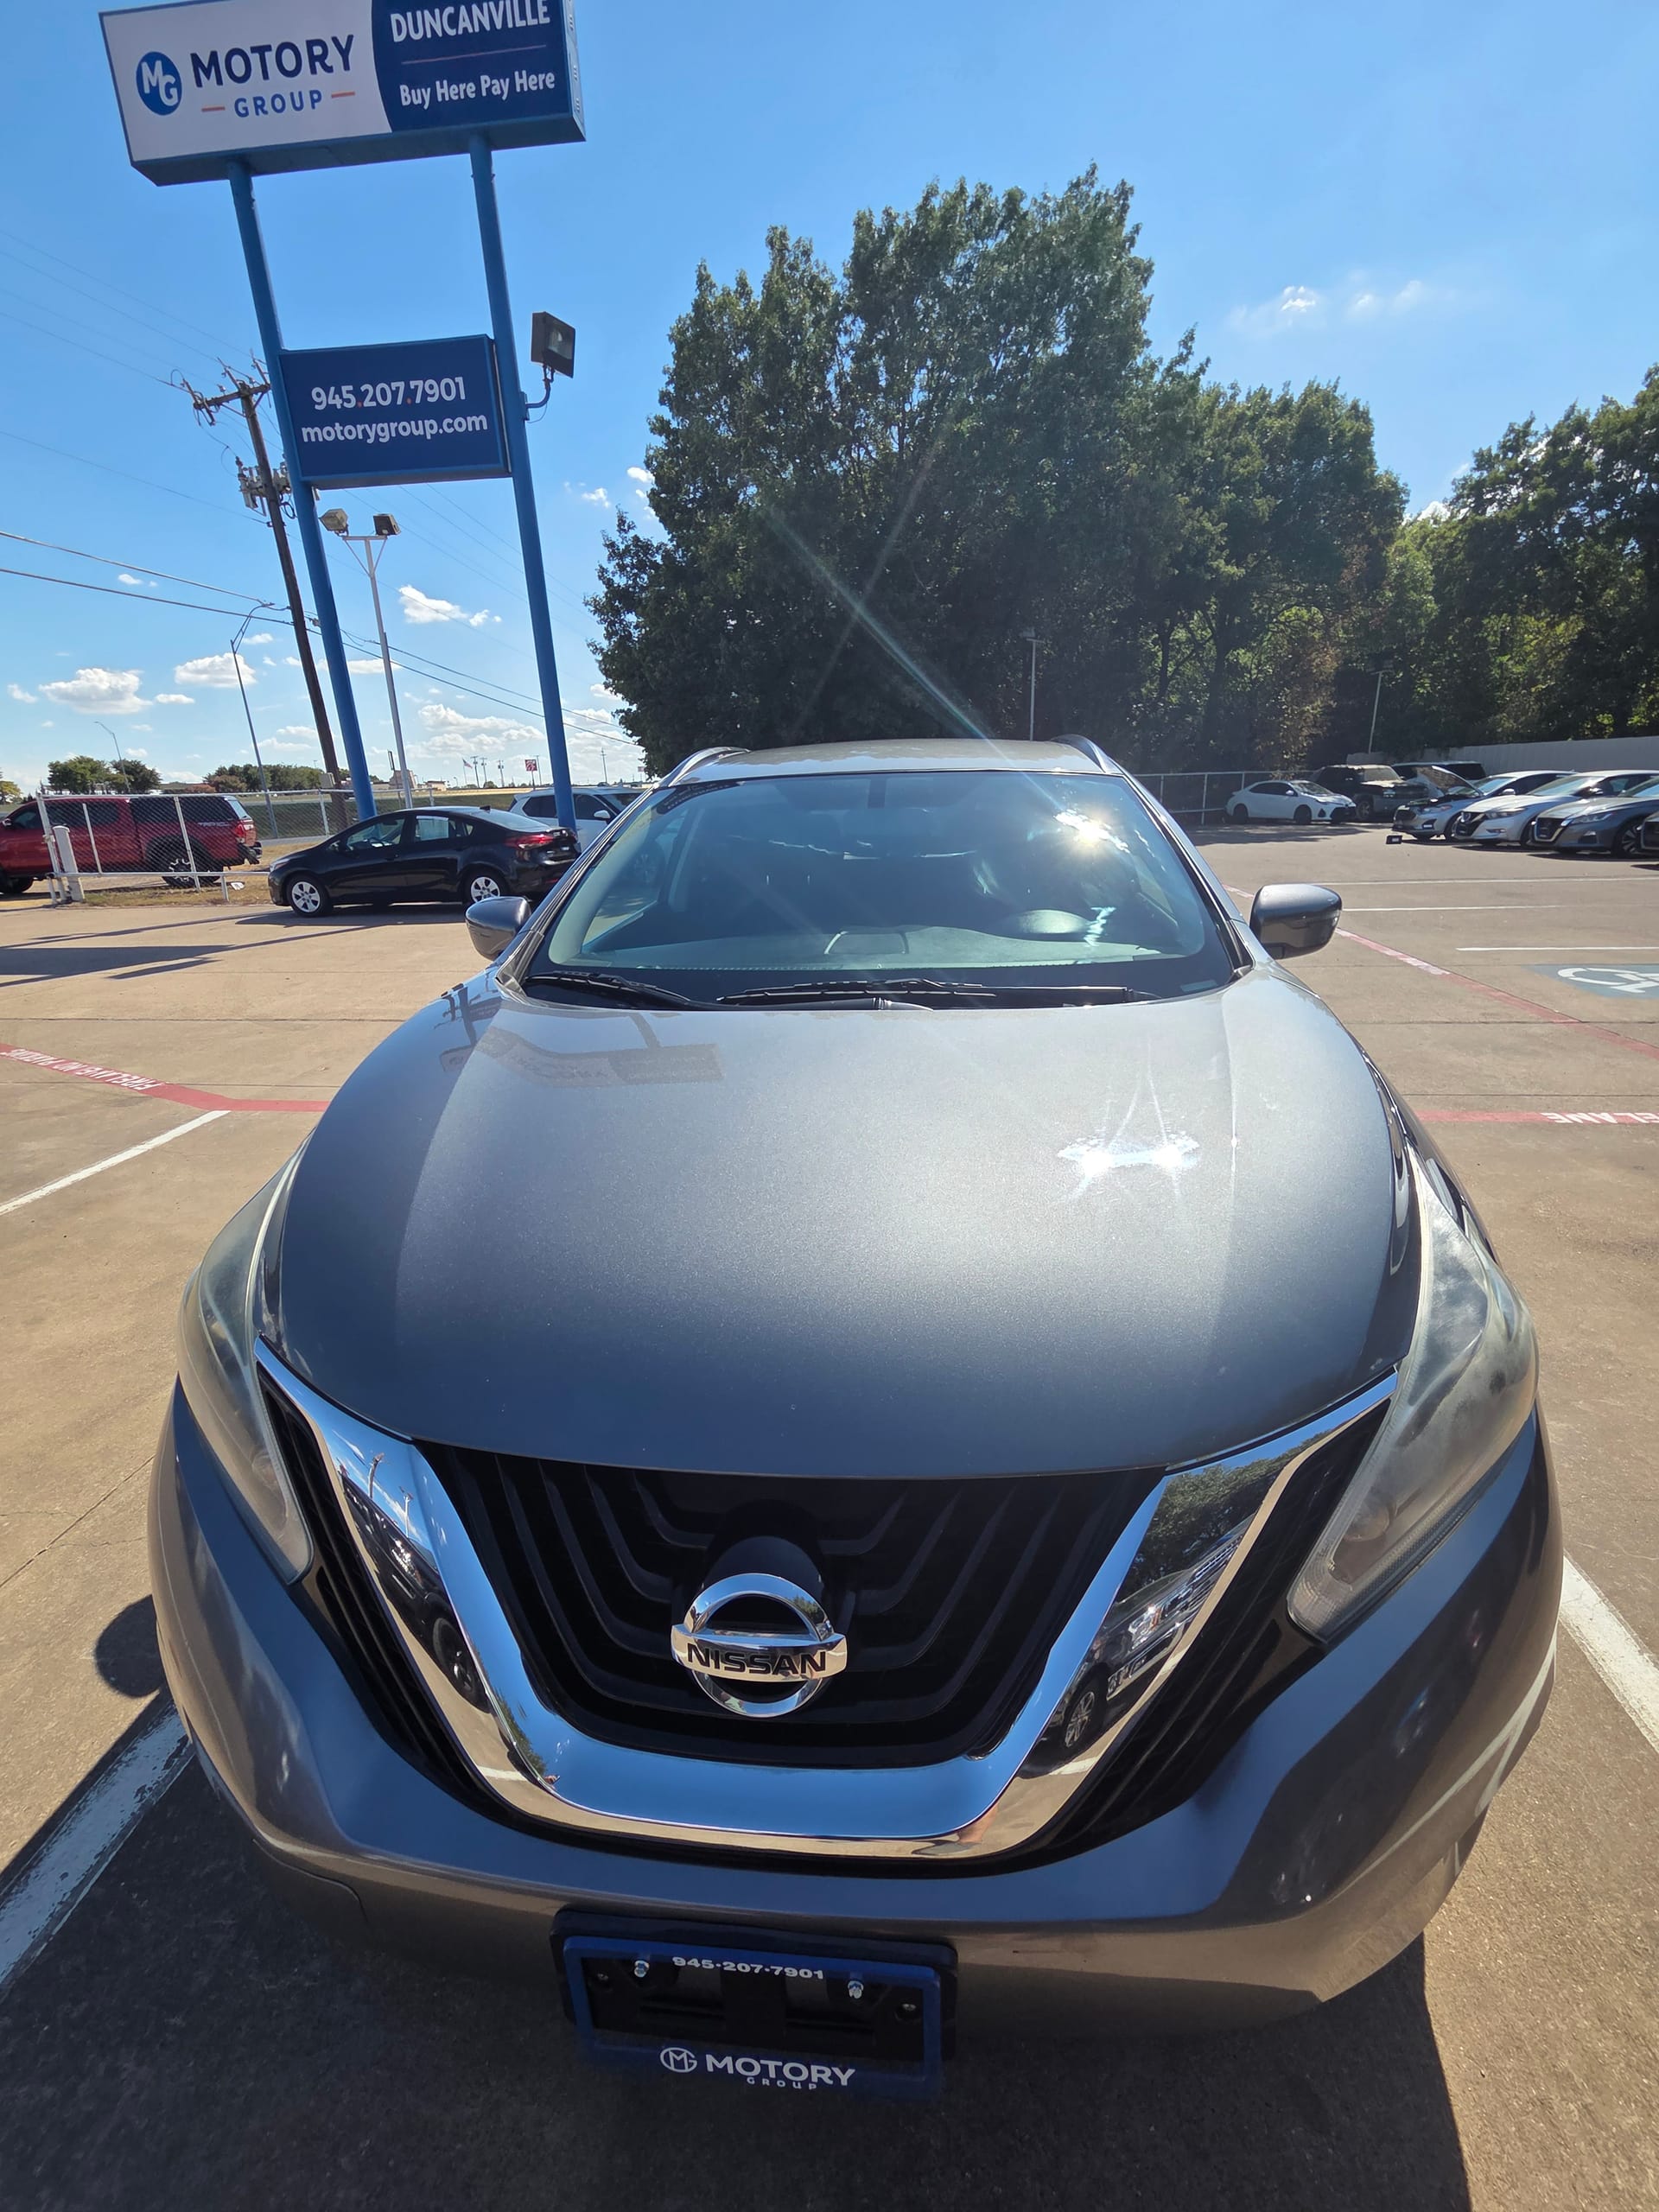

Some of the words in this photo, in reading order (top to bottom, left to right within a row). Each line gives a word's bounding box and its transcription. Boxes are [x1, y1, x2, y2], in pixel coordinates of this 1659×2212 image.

[391, 0, 550, 42] DUNCANVILLE
[190, 34, 354, 87] MOTORY
[141, 60, 179, 107] MG
[399, 84, 431, 110] Buy
[435, 79, 476, 103] Here
[480, 74, 510, 100] Pay
[514, 69, 556, 92] Here
[233, 89, 322, 118] GROUP
[311, 376, 466, 410] 945.207.7901
[302, 414, 488, 443] motorygroup.com
[1541, 1111, 1649, 1123] LANE
[687, 1643, 827, 1675] NISSAN
[705, 2054, 856, 2086] MOTORY
[747, 2076, 817, 2090] GROUP
